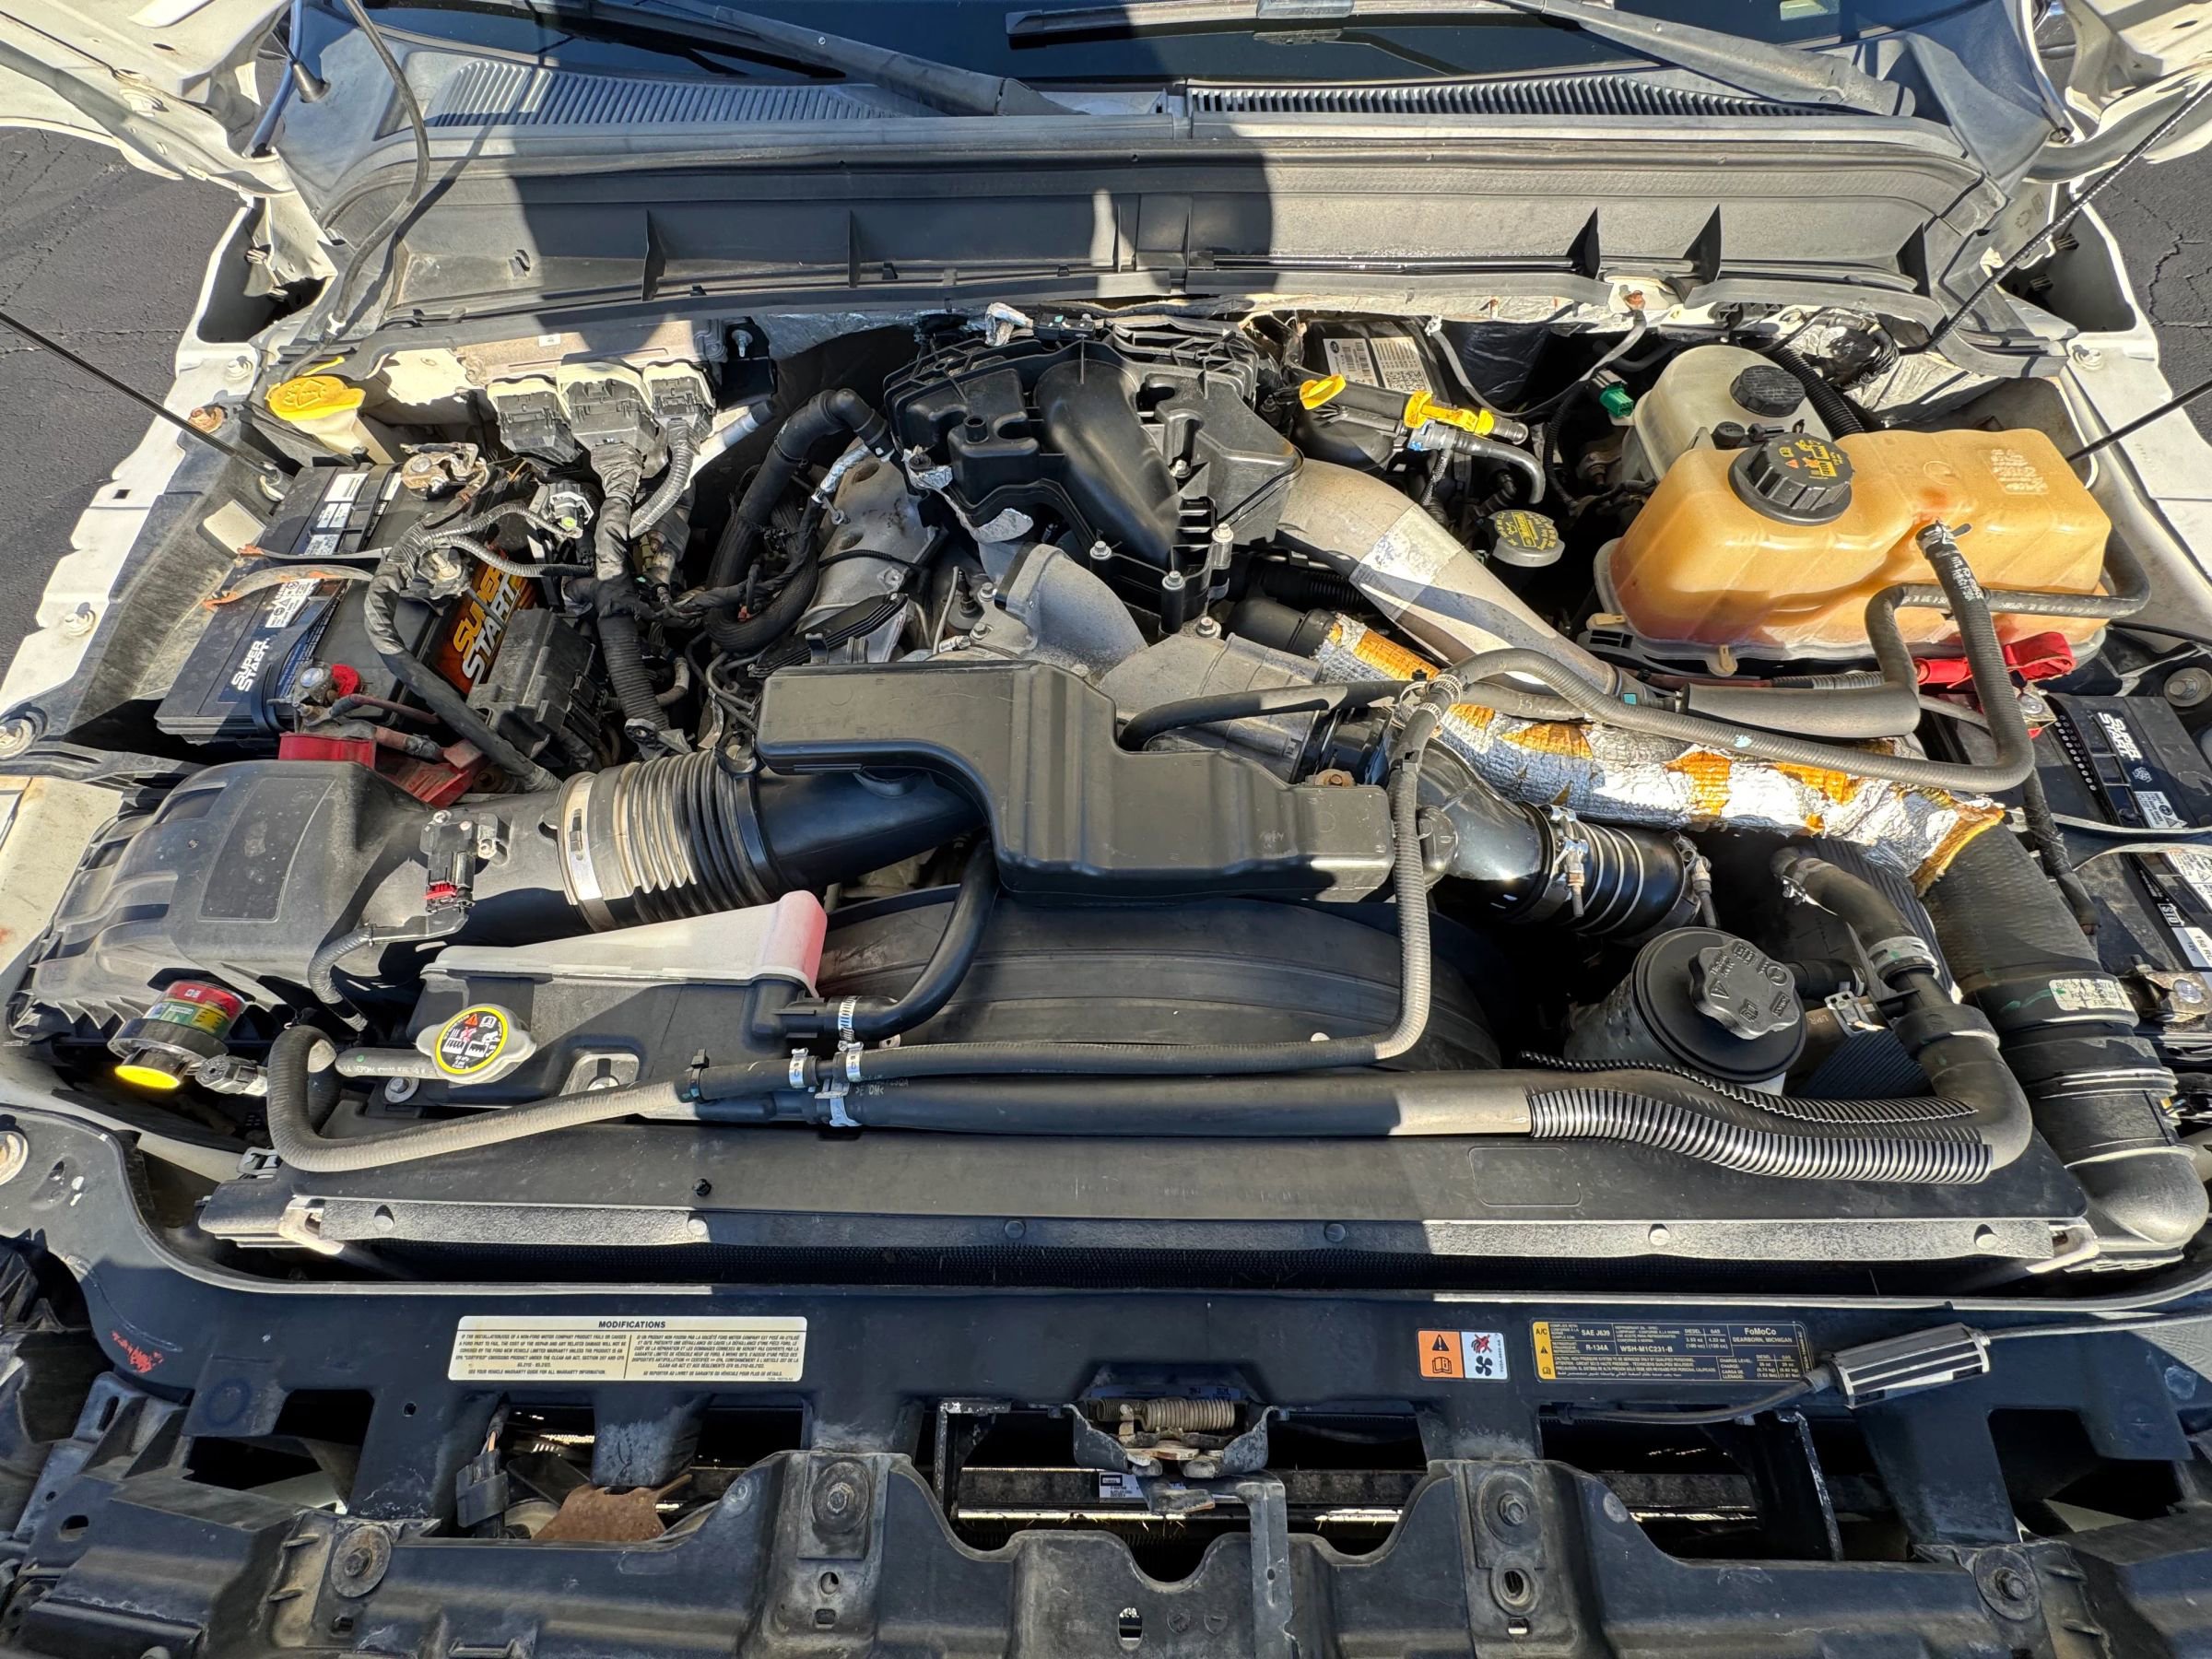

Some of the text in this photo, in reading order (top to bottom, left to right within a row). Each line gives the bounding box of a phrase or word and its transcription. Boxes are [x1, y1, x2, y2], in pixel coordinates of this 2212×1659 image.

[231, 641, 264, 685] SUPER
[238, 640, 269, 691] START
[2098, 712, 2128, 758] START
[2113, 717, 2143, 761] SUPER
[1744, 1327, 1777, 1335] FoMoCo
